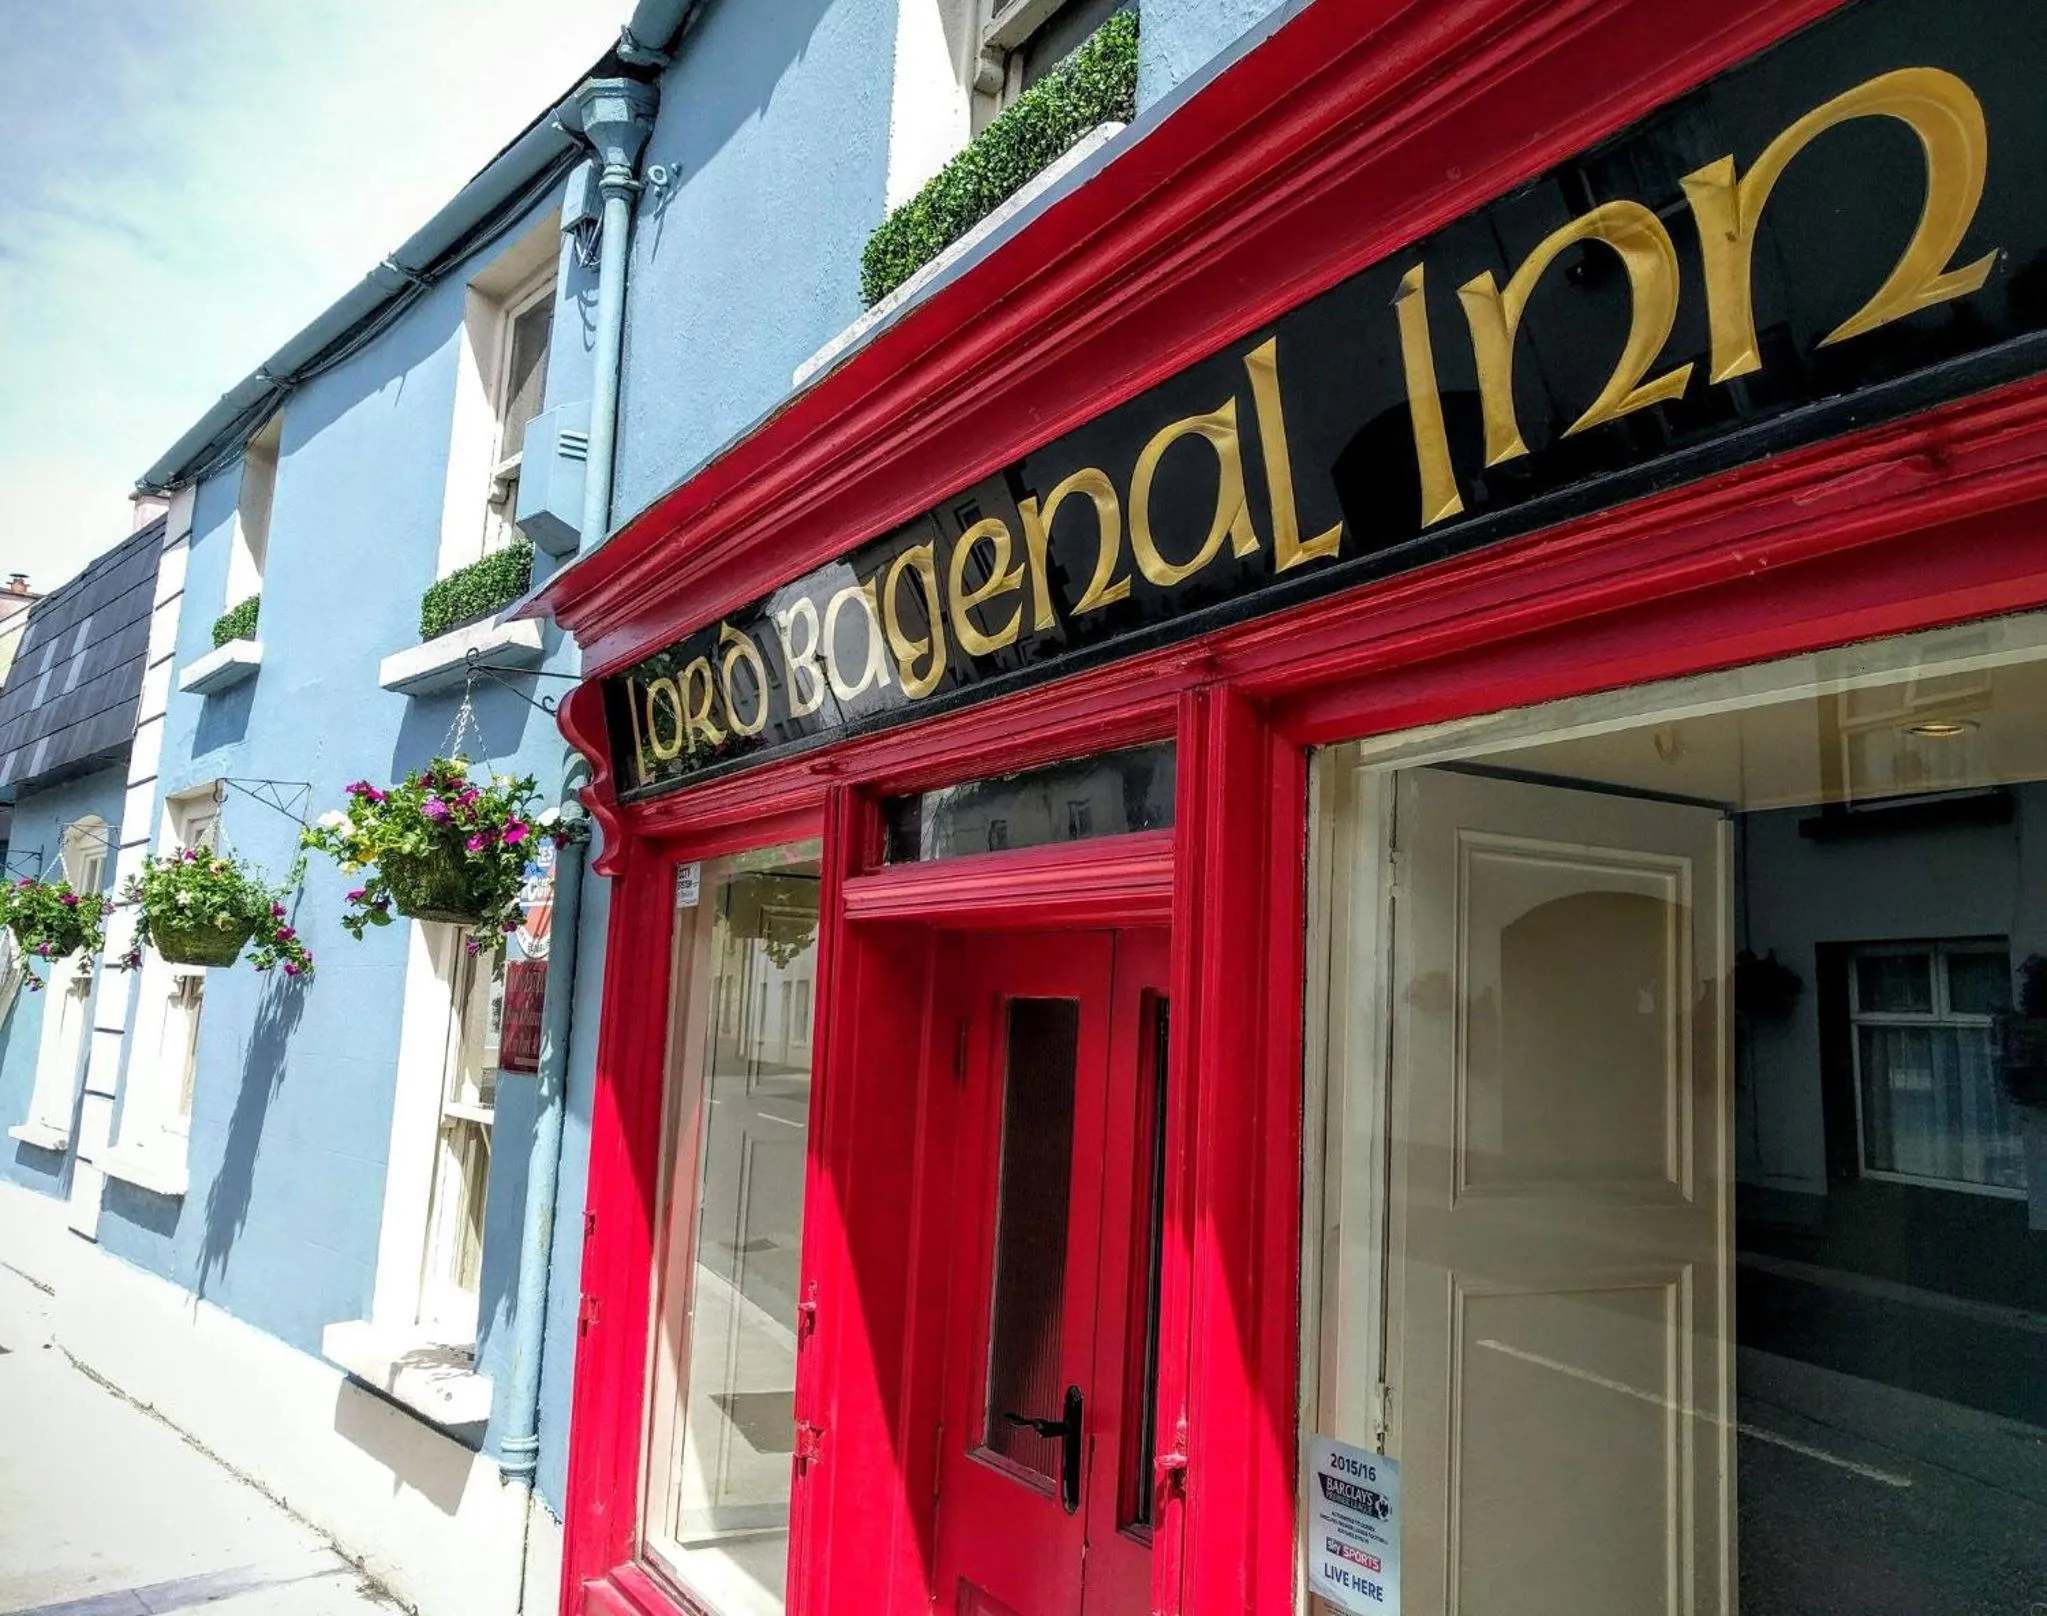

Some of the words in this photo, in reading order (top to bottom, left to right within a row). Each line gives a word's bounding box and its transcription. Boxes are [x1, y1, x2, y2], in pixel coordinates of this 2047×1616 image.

[1393, 66, 1999, 529] Inn
[1330, 1453, 1377, 1482] 2015/16
[1326, 1477, 1374, 1506] BARCLAYS
[1343, 1546, 1380, 1570] SPORTS
[1324, 1563, 1349, 1587] LIVE
[1352, 1575, 1383, 1603] HERE
